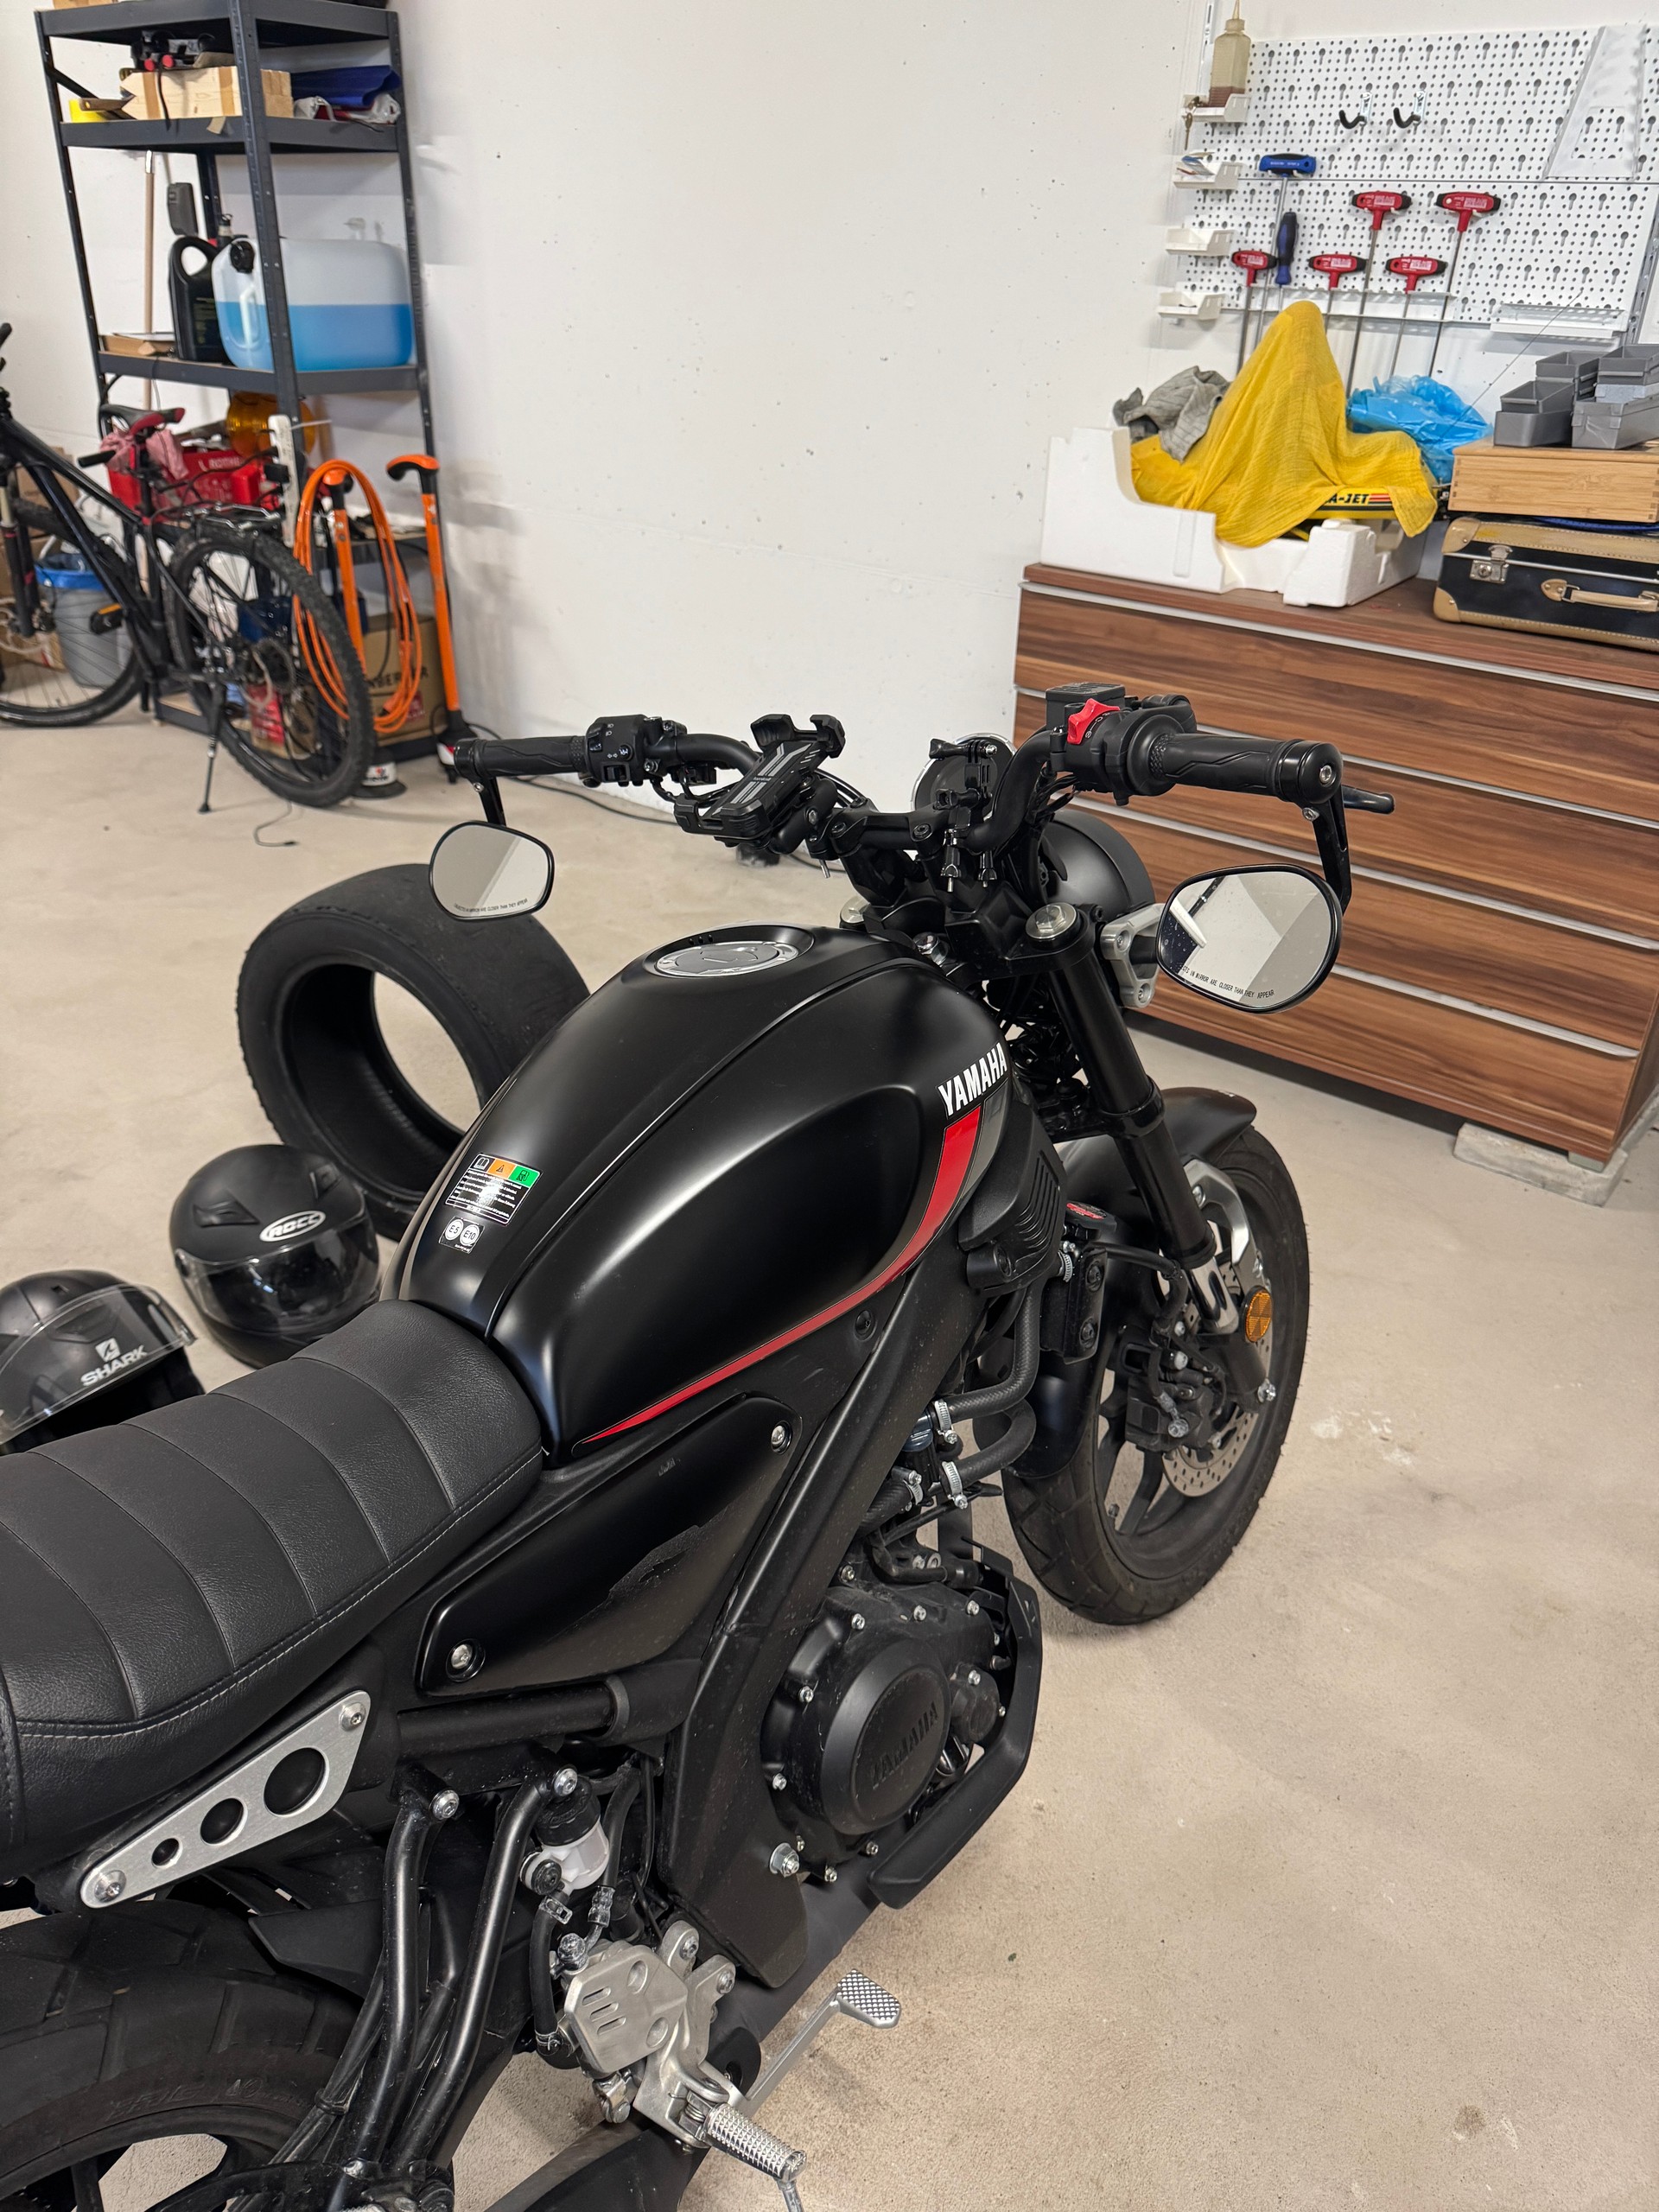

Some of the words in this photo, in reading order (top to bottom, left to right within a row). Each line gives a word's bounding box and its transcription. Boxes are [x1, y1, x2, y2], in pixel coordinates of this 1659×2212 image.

[1328, 493, 1370, 504] A-JET
[1195, 972, 1210, 983] MIRROR
[1209, 978, 1218, 987] ARE
[1218, 982, 1233, 992] CLOSER
[1233, 986, 1244, 995] THAN
[1244, 989, 1255, 998] THEY
[1256, 988, 1274, 999] APPEAR
[938, 1042, 1007, 1116] YAMAHA
[463, 1230, 476, 1240] E10
[80, 1344, 148, 1386] SHARK
[871, 1700, 938, 1786] YAMAHA
